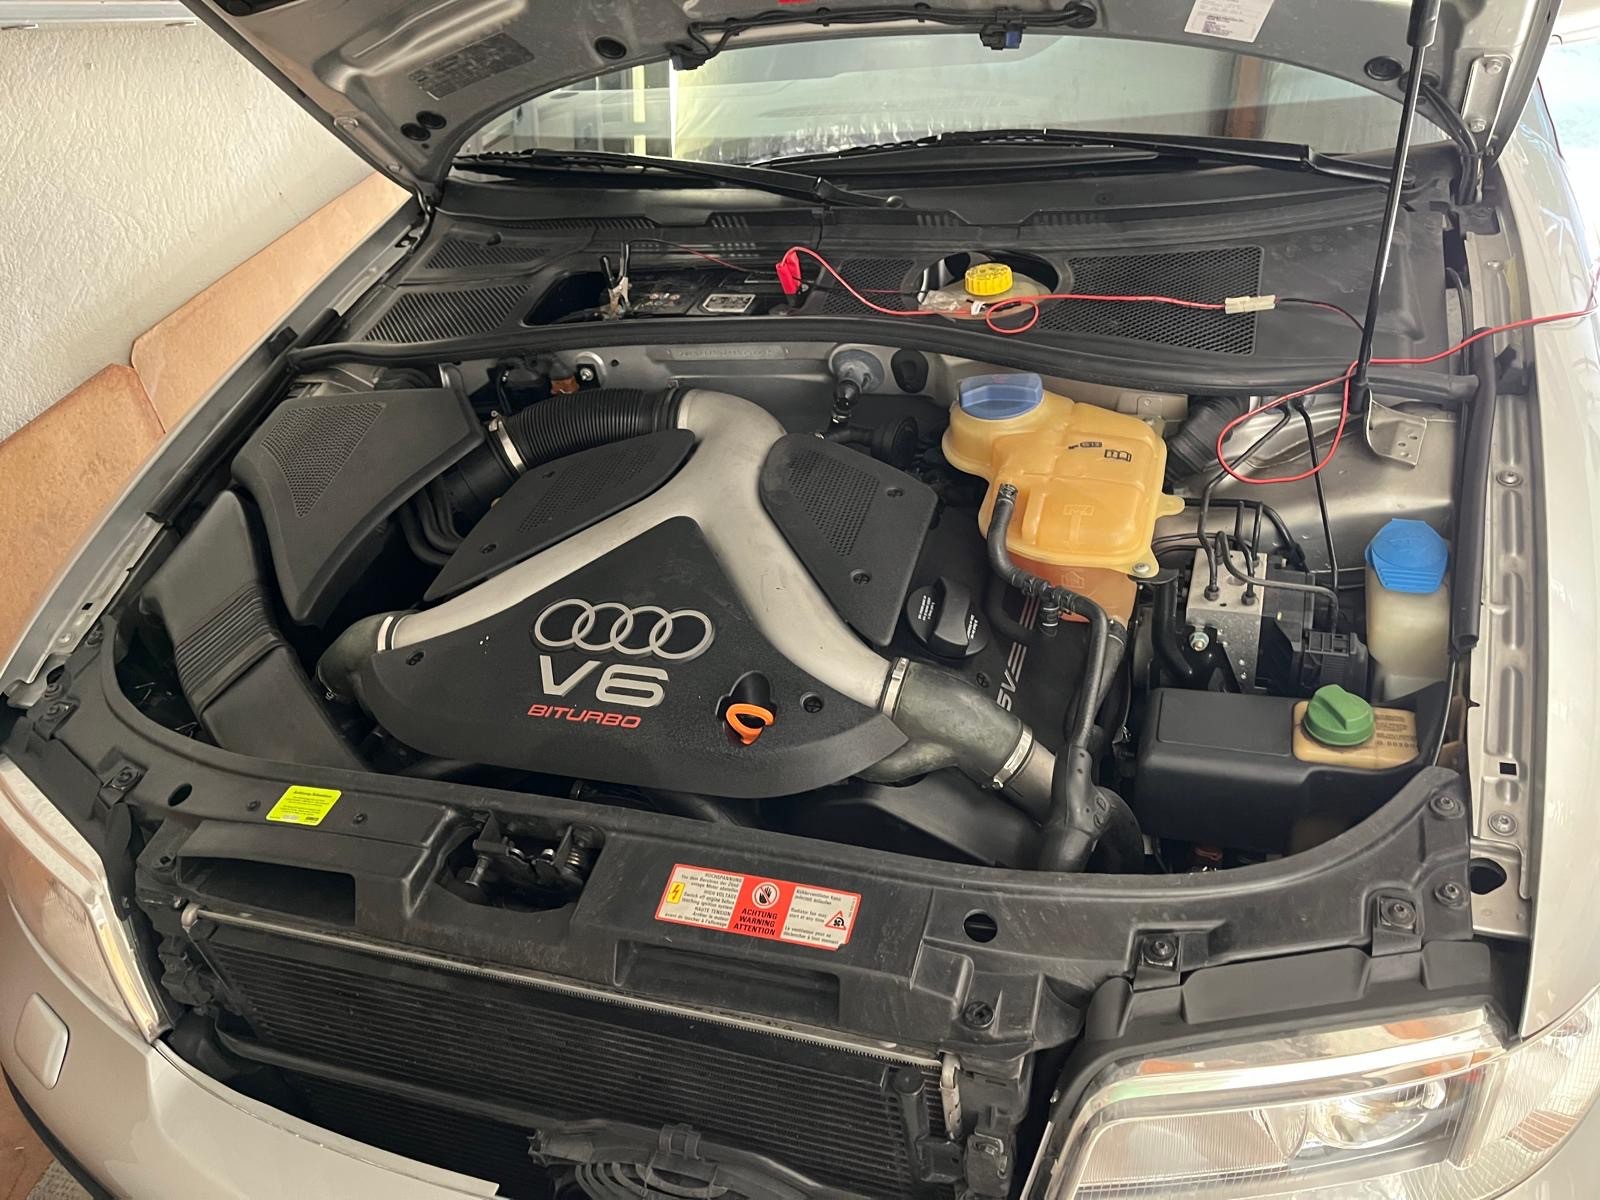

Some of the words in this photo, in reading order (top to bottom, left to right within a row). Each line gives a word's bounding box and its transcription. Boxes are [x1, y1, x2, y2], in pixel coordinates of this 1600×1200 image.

[540, 655, 669, 708] V6
[528, 704, 641, 728] BITURBO
[741, 908, 778, 920] ACHTUNG
[739, 915, 775, 927] WARNING
[733, 923, 776, 936] ATTENTION
